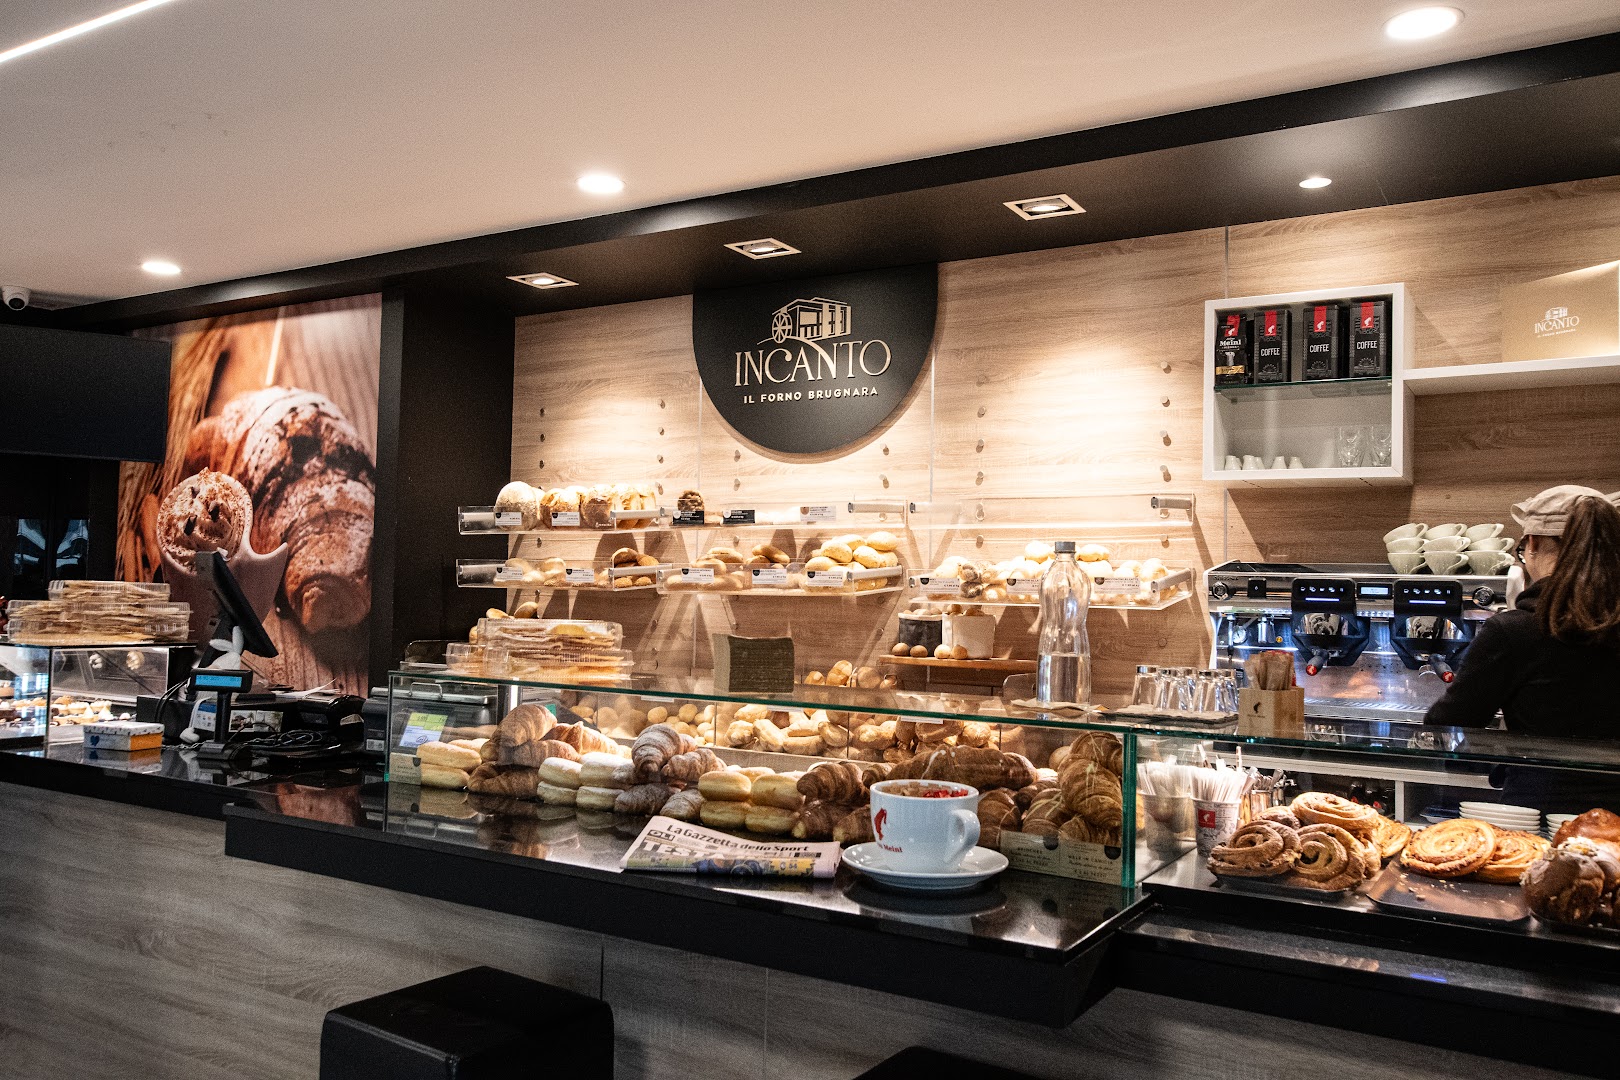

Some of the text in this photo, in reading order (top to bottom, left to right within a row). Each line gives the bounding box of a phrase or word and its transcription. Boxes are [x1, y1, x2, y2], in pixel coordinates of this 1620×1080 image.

[1534, 316, 1579, 333] INCANTO
[1219, 339, 1241, 347] Meinl
[1309, 344, 1329, 352] COFFEE
[1356, 341, 1377, 349] COFFEE
[1261, 348, 1280, 356] COFFEE
[734, 339, 892, 387] INCANTO
[743, 387, 878, 403] IL FORNO BRUGNARA
[666, 824, 683, 836] La
[683, 829, 739, 848] Gazzetta
[740, 843, 772, 852] dello
